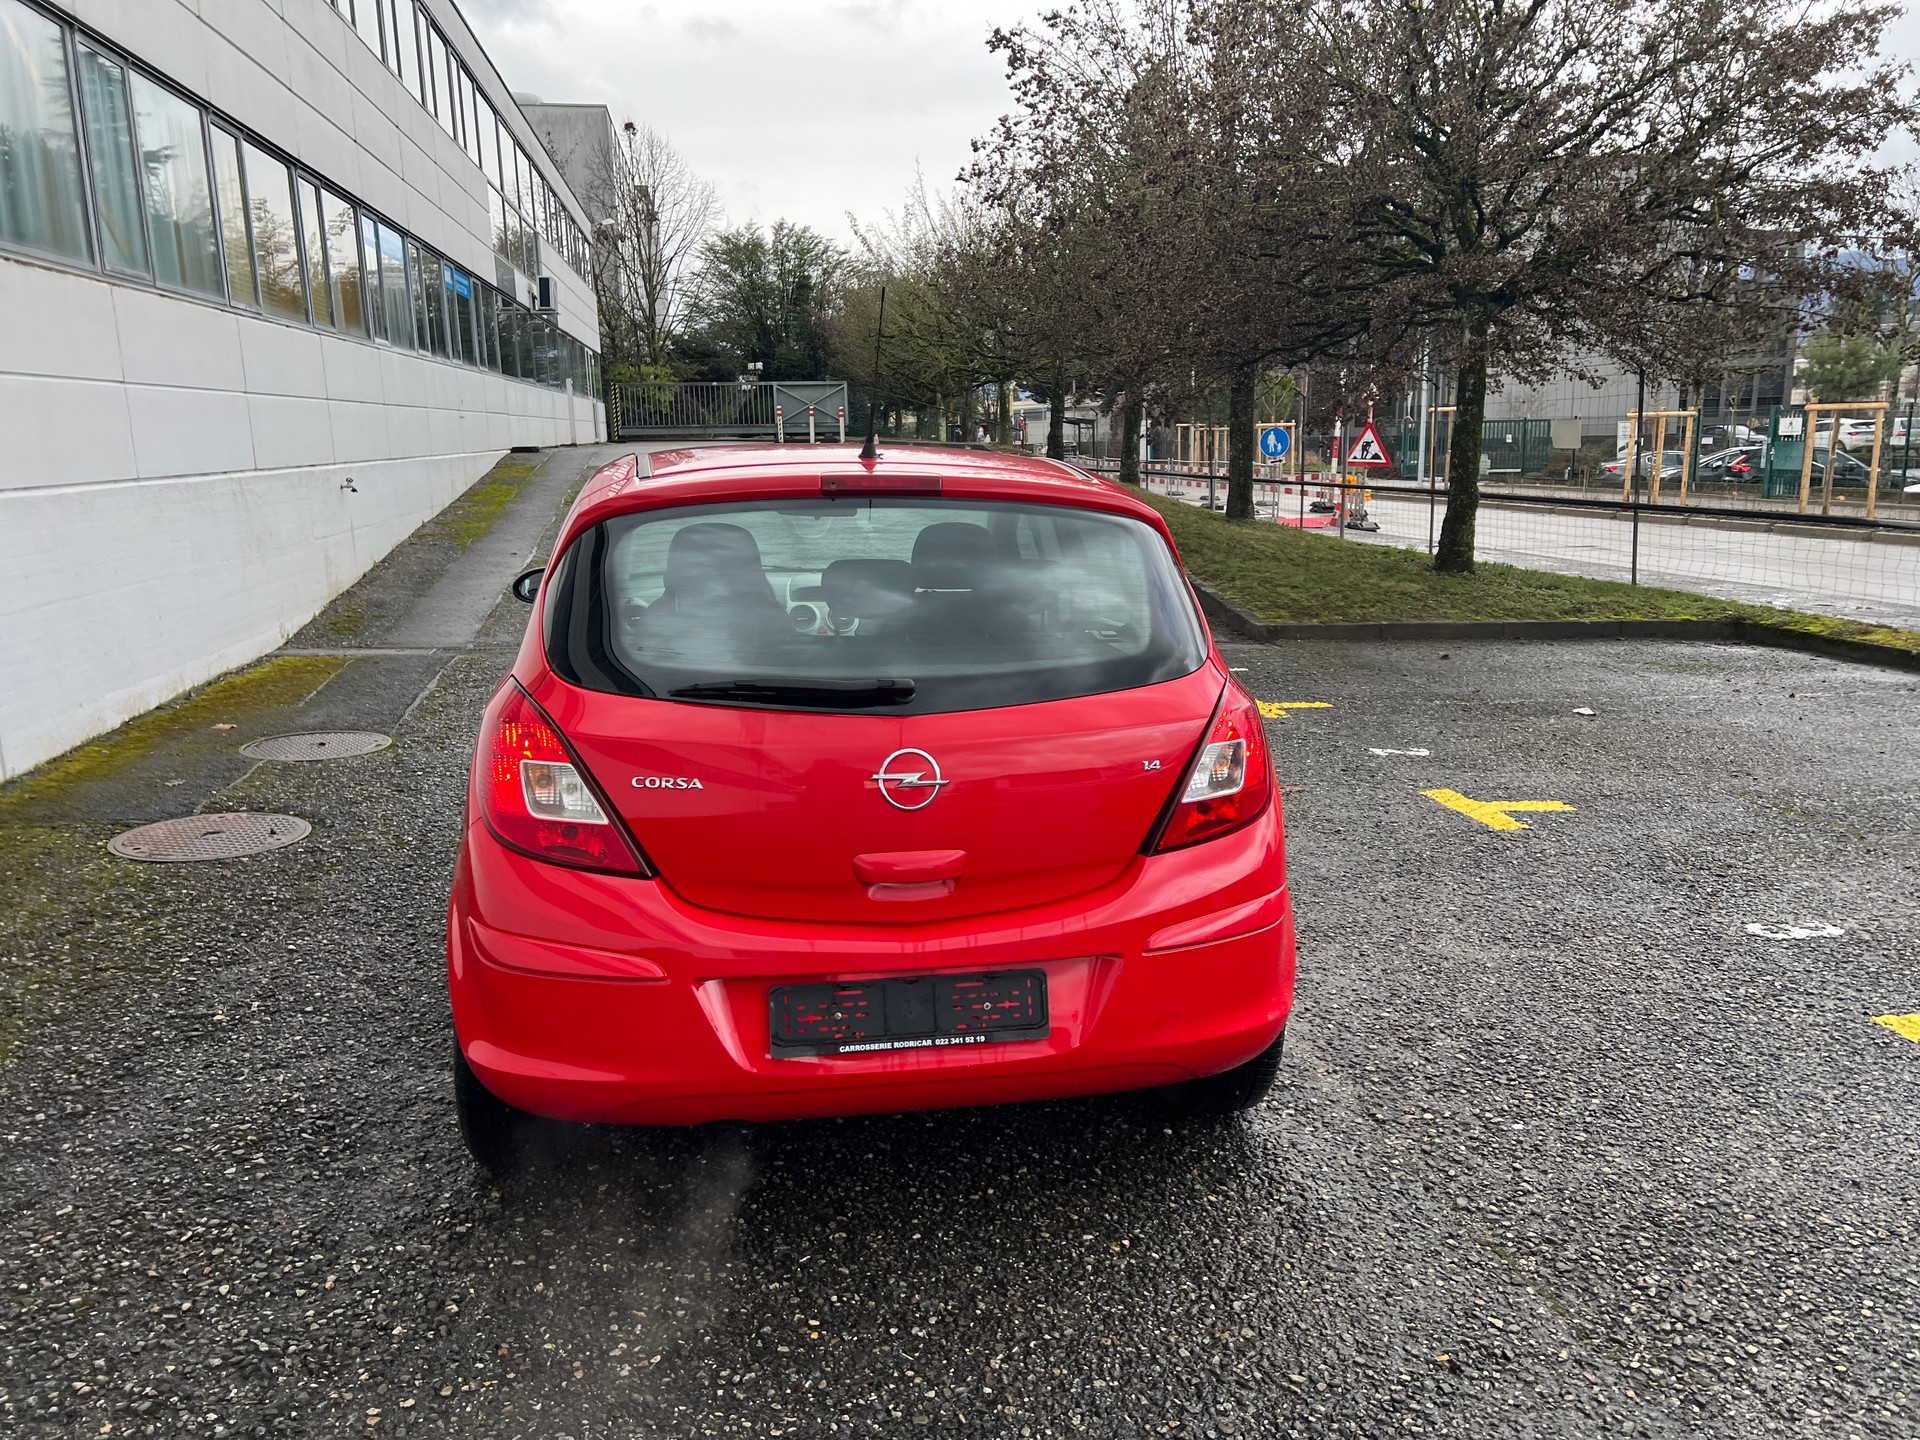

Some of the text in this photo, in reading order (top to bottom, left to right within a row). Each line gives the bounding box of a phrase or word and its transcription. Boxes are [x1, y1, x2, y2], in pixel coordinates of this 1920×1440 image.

[631, 776, 704, 789] CORSA
[839, 1042, 892, 1053] CARROSSERIE
[893, 1039, 932, 1049] RODRICAR
